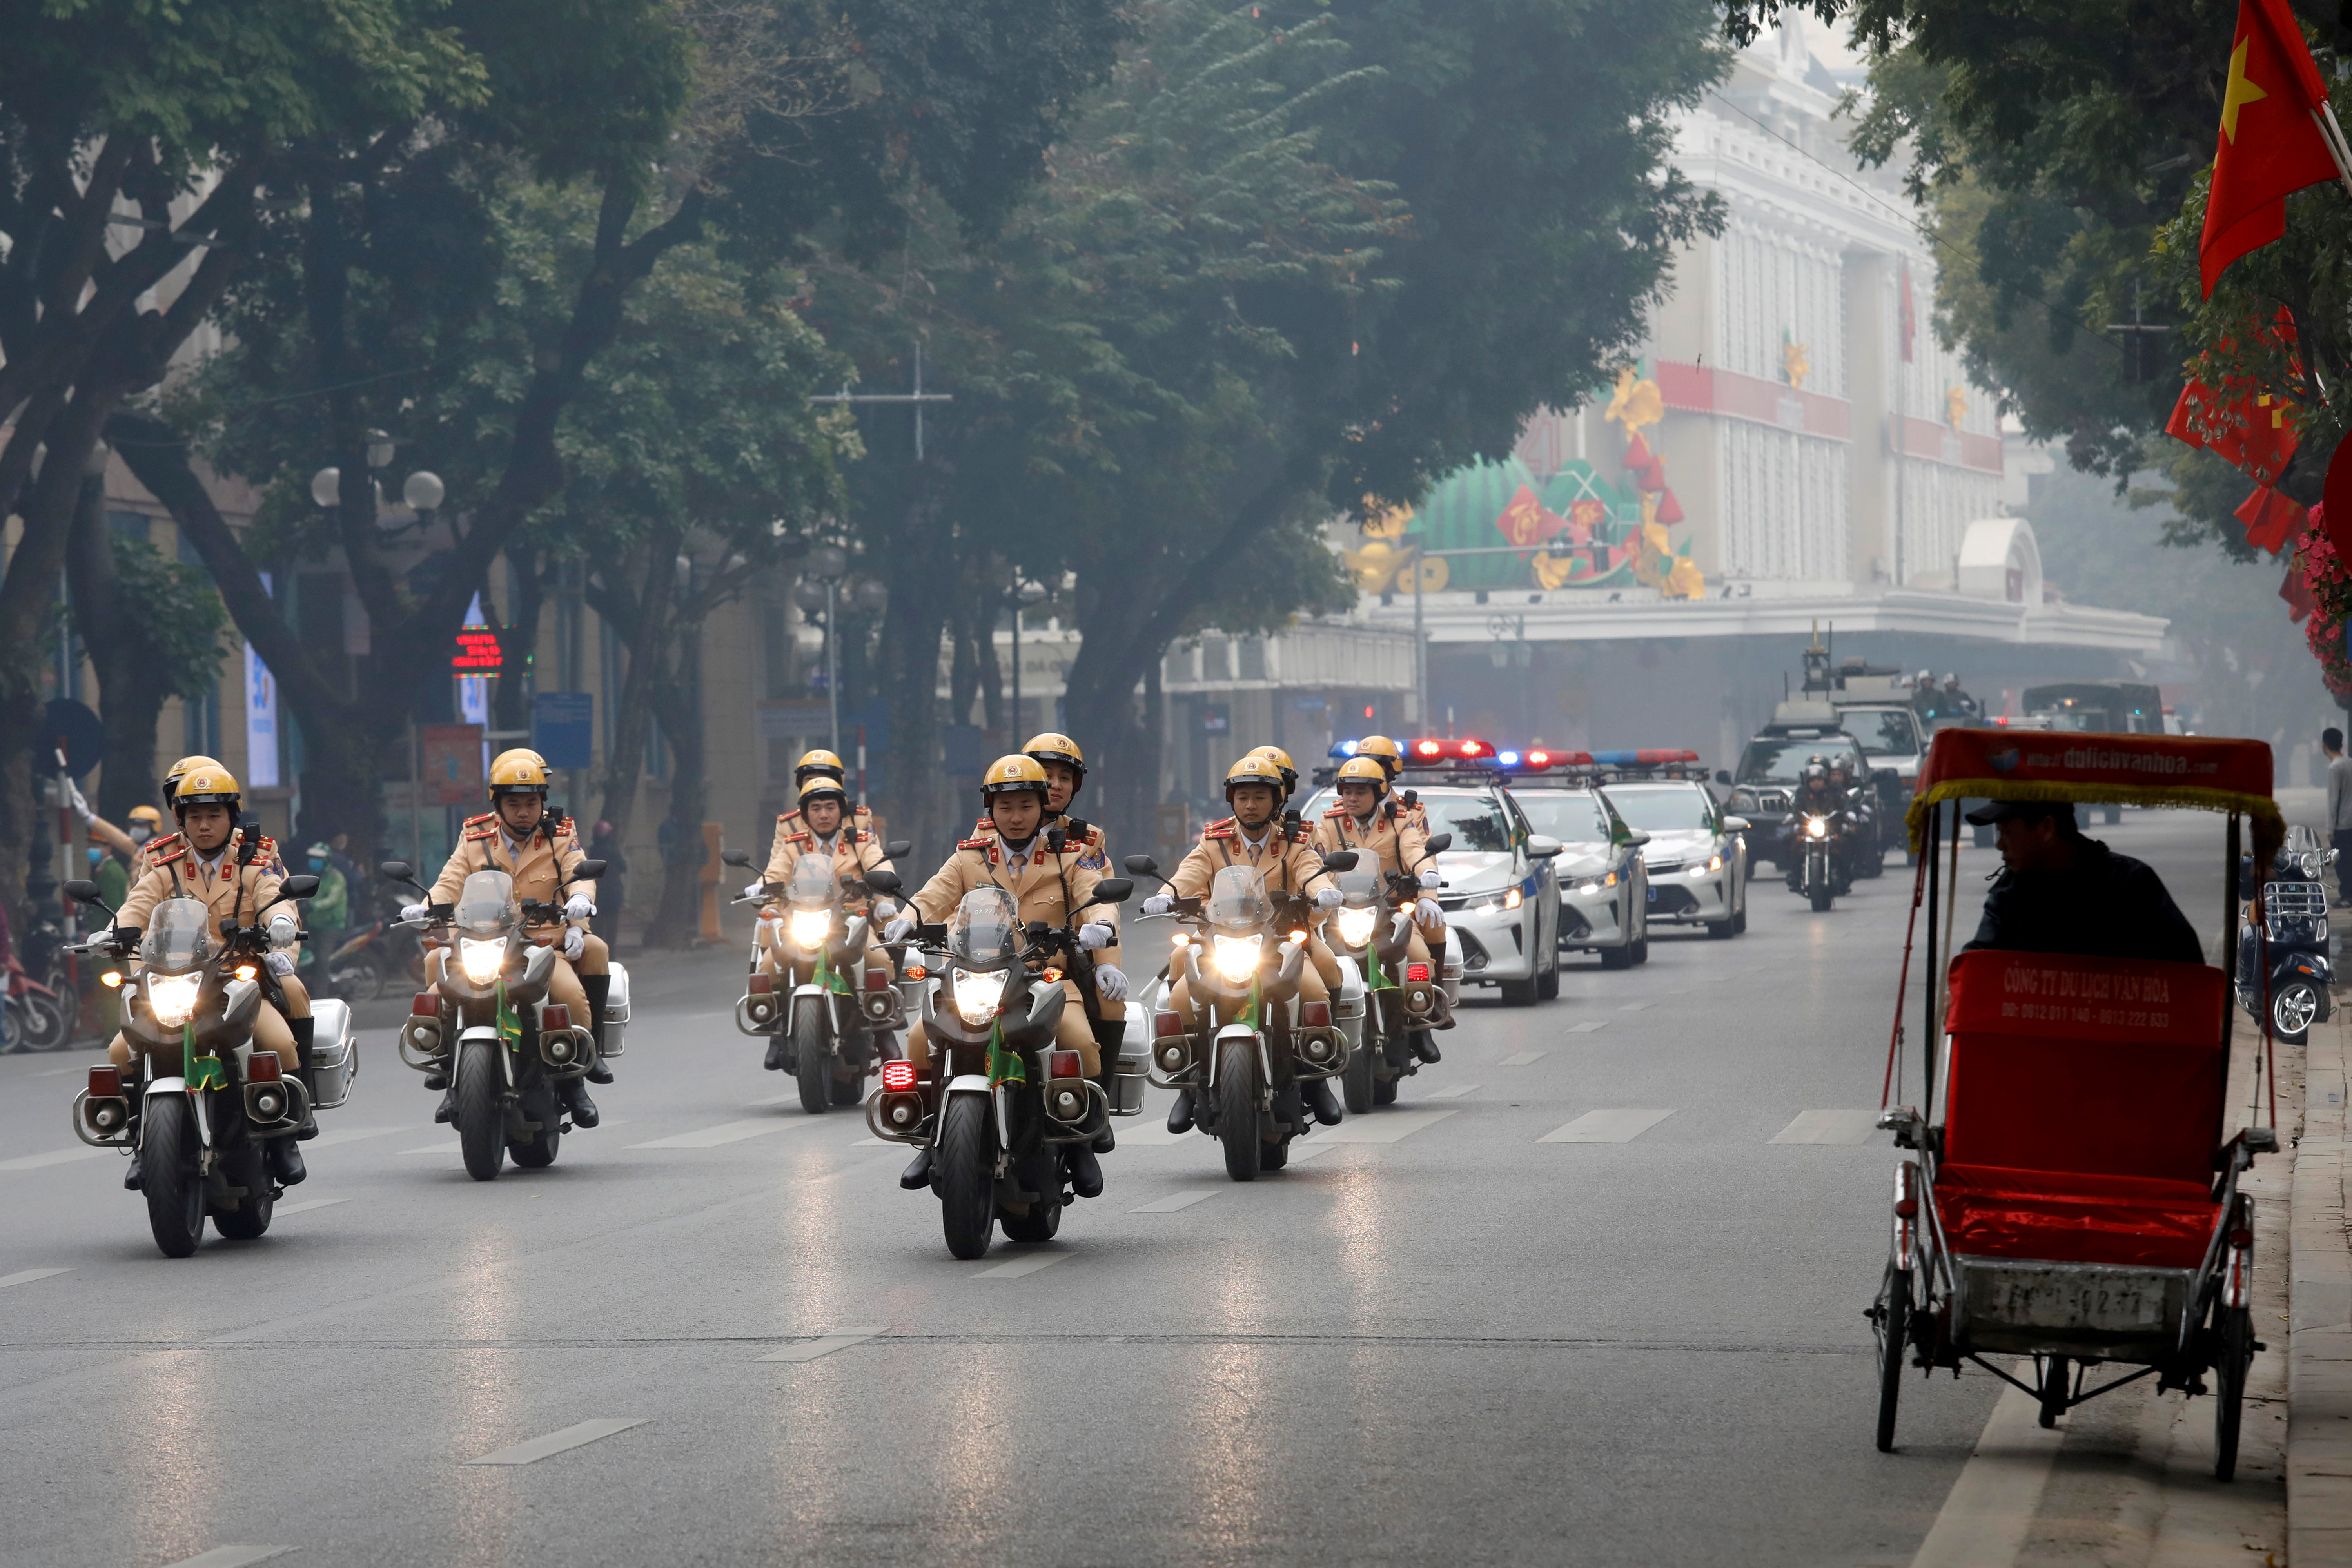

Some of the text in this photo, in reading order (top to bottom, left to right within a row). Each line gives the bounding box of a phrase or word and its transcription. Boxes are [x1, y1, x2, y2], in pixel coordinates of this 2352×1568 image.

[2004, 960, 2038, 995] CÔNG
[2041, 969, 2059, 996] TY
[2059, 971, 2079, 997] DU
[2049, 1005, 2068, 1021] 011
[2127, 1010, 2148, 1027] 222
